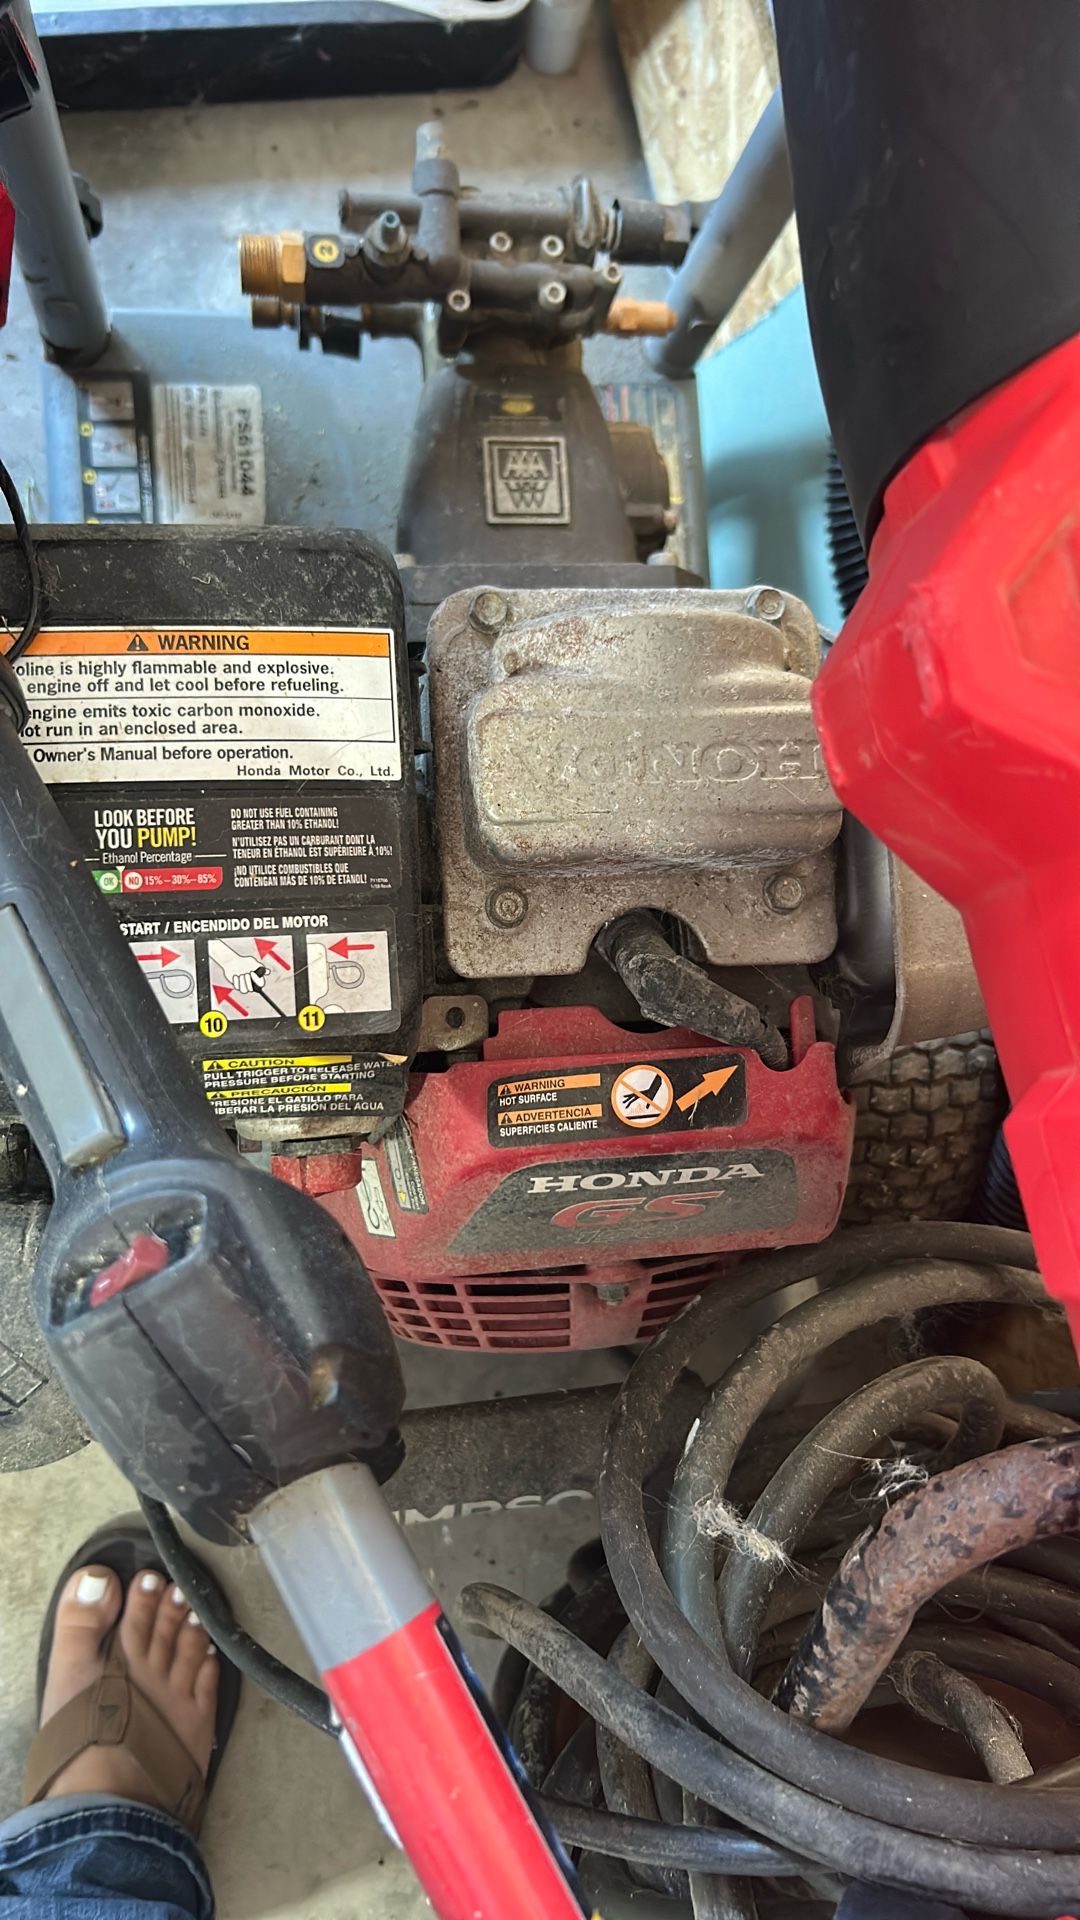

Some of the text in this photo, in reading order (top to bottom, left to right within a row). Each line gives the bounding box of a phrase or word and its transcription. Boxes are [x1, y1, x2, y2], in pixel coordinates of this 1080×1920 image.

[158, 635, 249, 650] WARNING
[12, 660, 334, 677] oline is highly flammable and explosive.
[27, 678, 344, 695] engine off and let cool before refueling.
[83, 704, 127, 718] emits
[132, 704, 171, 717] toxic
[177, 703, 233, 717] carbon
[239, 703, 320, 717] monoxide.
[46, 724, 73, 736] run
[79, 722, 93, 735] in
[99, 724, 118, 735] an
[124, 721, 196, 734] enclosed
[202, 723, 243, 734] area.
[33, 745, 294, 763] Owner's Manual before operation.
[237, 765, 394, 777] Honda Motor Co., Ltd.
[94, 807, 195, 827] LOOK BEFORE
[230, 807, 338, 819] DO NOT USE FUEL CONTAINING
[231, 818, 339, 830] GREATER THAN 10% ETHANOL!
[95, 826, 197, 849] YOU PUMP!
[231, 834, 376, 847] N'UTILISEZ PAS UN CARBURANT DONT LA
[102, 851, 192, 864] Ethanol Percentage
[232, 848, 261, 859] TENEUR
[263, 848, 273, 858] EN
[274, 846, 307, 858] ÉTHANOL
[308, 847, 322, 857] EST
[324, 845, 367, 857] SUPÉRIEURE
[375, 845, 393, 856] 10%!
[233, 863, 349, 877] ¡NO UTILICE COMBUSTIBLES QUE
[103, 877, 115, 887] OK
[128, 875, 140, 885] NO
[144, 876, 163, 886] 15%
[171, 874, 191, 885] 30%
[234, 876, 278, 888] CONTENGAN
[279, 874, 296, 886] MÁS
[298, 875, 308, 886] DE
[309, 875, 325, 885] 10%
[326, 875, 336, 885] DE
[337, 874, 367, 885] ETANOL!
[119, 915, 329, 936] START / ENCENDIDO DEL MOTOR
[204, 1017, 223, 1033] 10
[302, 1011, 319, 1027] 11
[228, 1058, 295, 1069] CAUTION
[203, 1072, 234, 1081] PULL
[235, 1067, 288, 1078] TRIGGER
[290, 1066, 305, 1074] TO
[311, 1063, 360, 1074] RELEASE
[204, 1070, 376, 1089] PRESSURE BEFORE STARTING
[231, 1083, 327, 1097] PRECAUCIÓN
[514, 1079, 566, 1092] WARNING
[268, 1096, 283, 1104] EL
[285, 1094, 331, 1103] GATILLO
[334, 1093, 364, 1101] PARA
[499, 1092, 557, 1107] HOT SURFACE
[214, 1102, 384, 1115] IBERAR LA PRESIÓN DEL AGUA
[515, 1108, 592, 1122] ADVERTENCIA
[500, 1120, 598, 1137] SUPERFICIES CALIENTE
[527, 1163, 765, 1193] HONDA
[551, 1190, 726, 1228] GS
